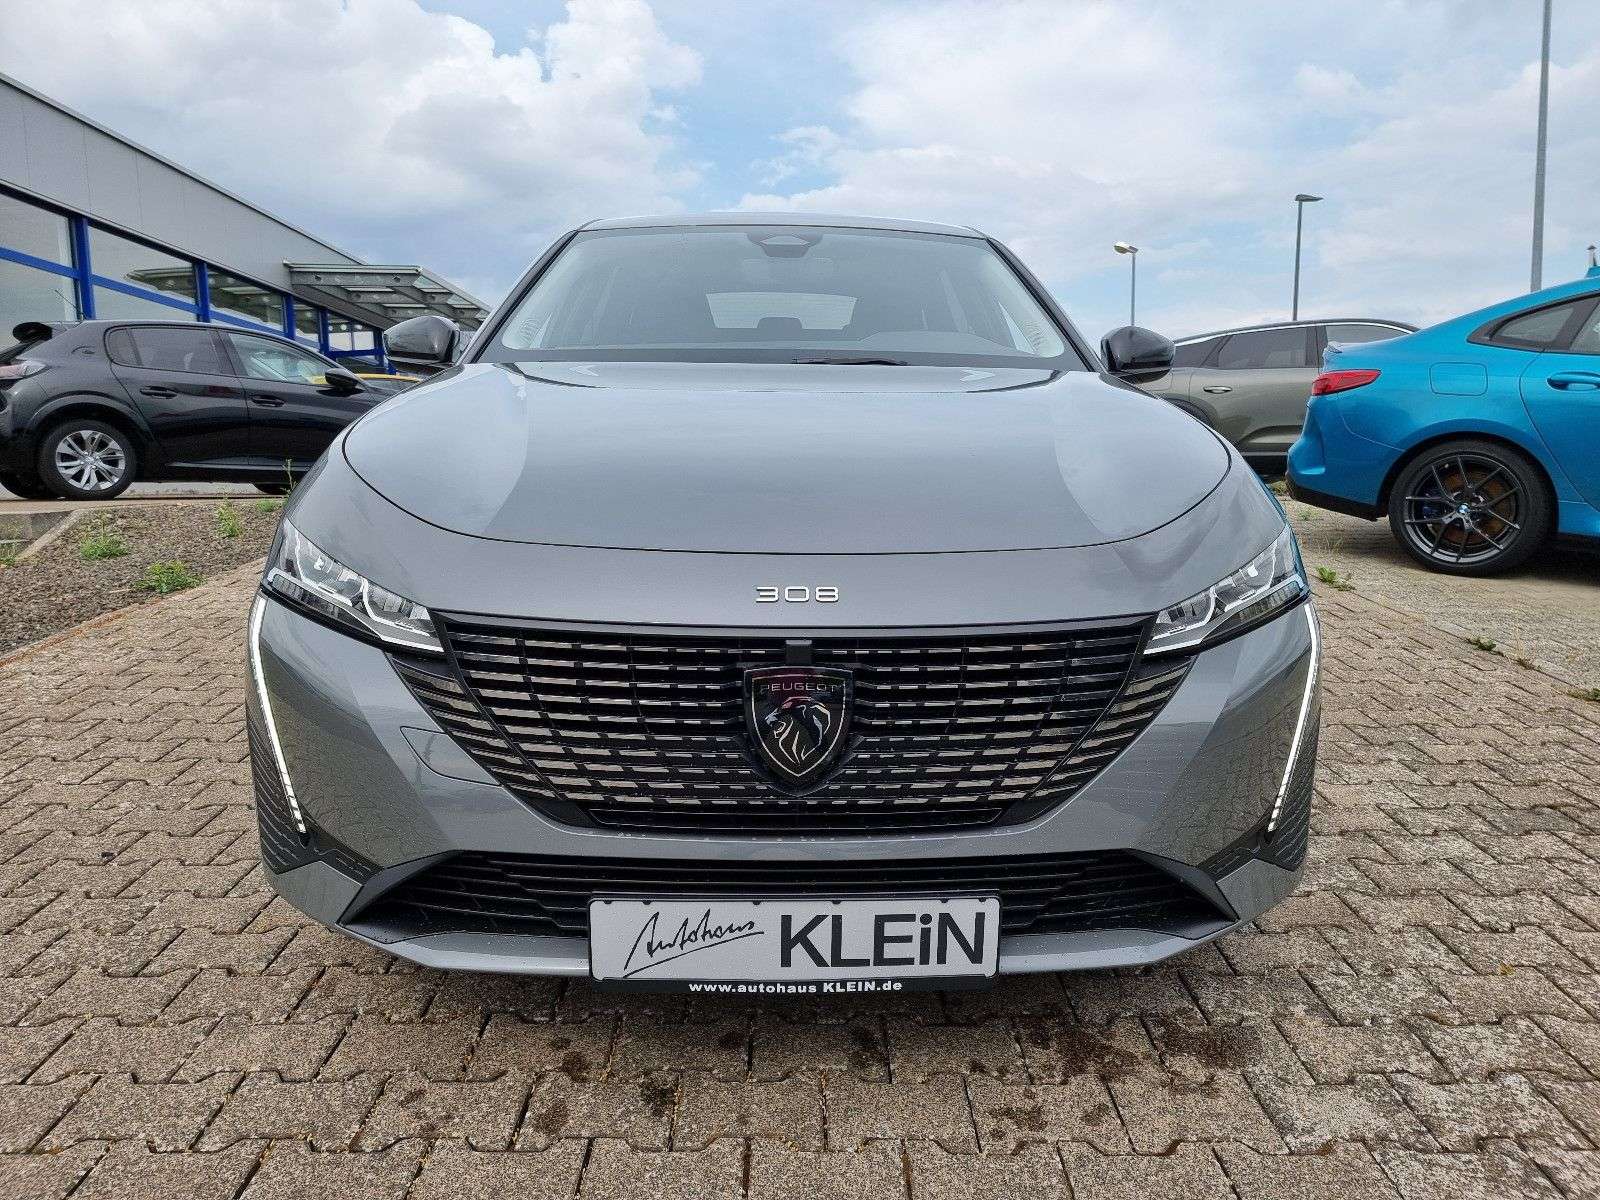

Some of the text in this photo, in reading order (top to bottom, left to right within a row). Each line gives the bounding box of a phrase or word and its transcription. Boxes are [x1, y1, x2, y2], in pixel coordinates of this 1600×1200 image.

[755, 586, 839, 602] 308
[760, 682, 838, 694] PEUGEOT
[623, 908, 756, 972] Autohaus
[688, 980, 903, 993] www.autohaus KLEIN.de
